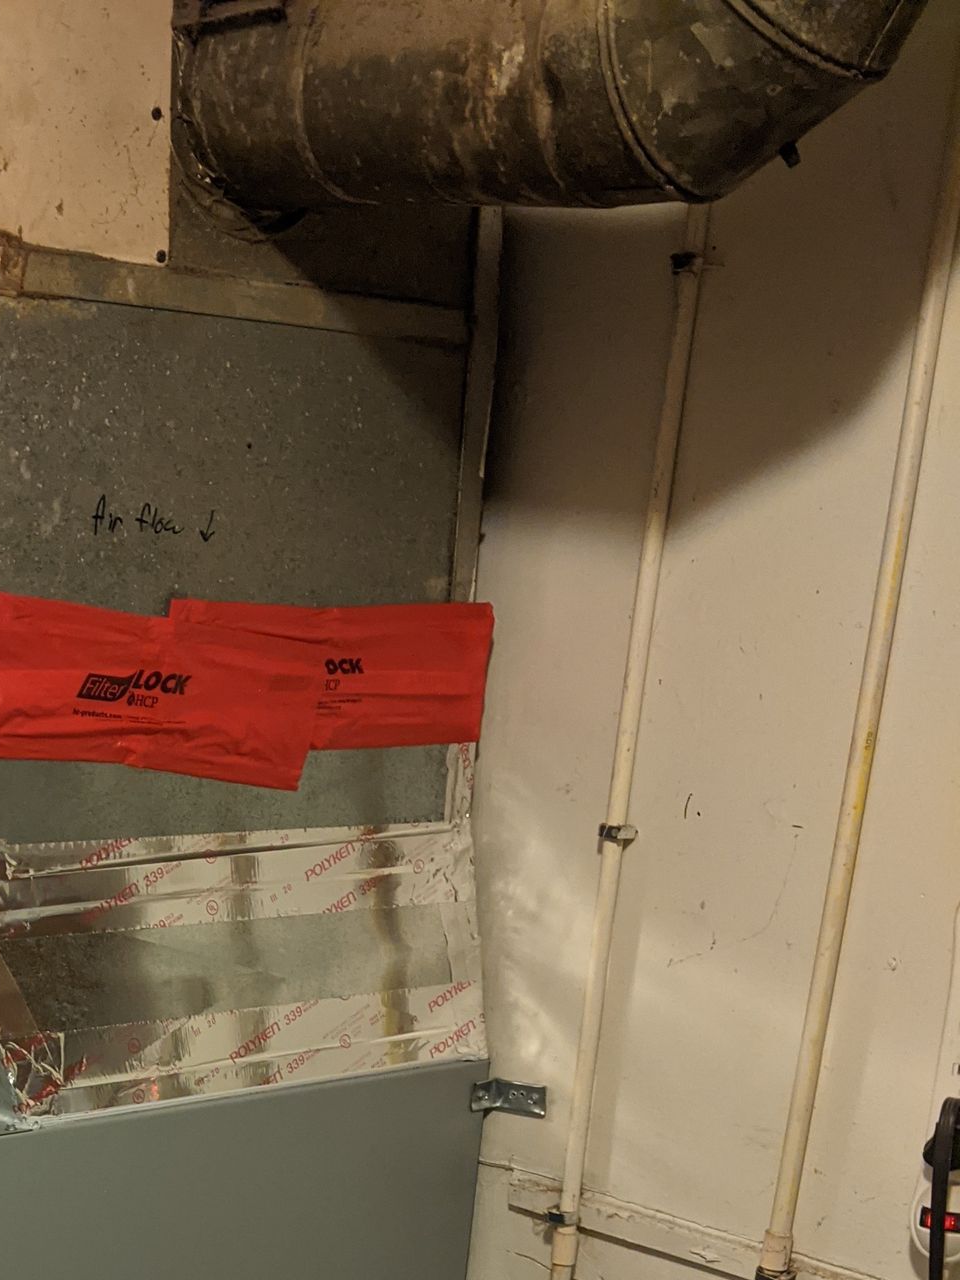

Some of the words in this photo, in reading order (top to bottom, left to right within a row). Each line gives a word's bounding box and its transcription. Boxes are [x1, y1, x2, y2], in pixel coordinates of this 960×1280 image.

[92, 494, 123, 535] Air
[324, 658, 365, 675] OCK
[81, 676, 126, 699] Filter
[132, 669, 192, 695] LOCK
[135, 694, 159, 708] HCP
[305, 841, 356, 882] POLYKEN
[143, 867, 165, 888] 339
[229, 1021, 282, 1064] POLYKEN
[283, 1005, 304, 1027] 339
[429, 1020, 477, 1058] POLYKEN
[286, 1054, 306, 1074] 339
